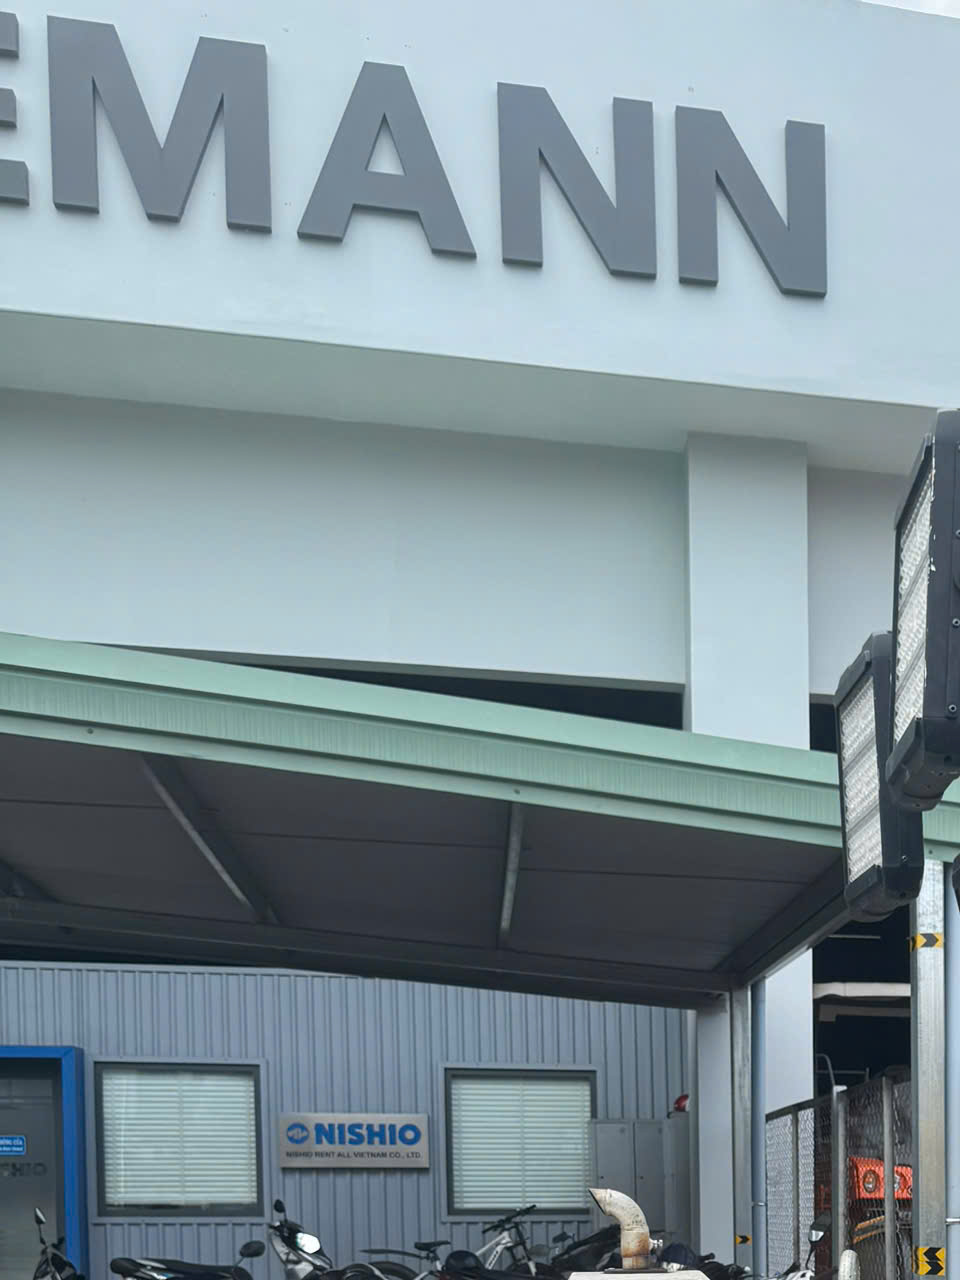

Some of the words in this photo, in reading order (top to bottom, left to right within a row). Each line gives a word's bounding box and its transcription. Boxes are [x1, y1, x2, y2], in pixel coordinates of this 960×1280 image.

[314, 1122, 422, 1146] NISHIO
[315, 1151, 336, 1159] RENT
[337, 1151, 351, 1159] ALL
[353, 1151, 388, 1159] VIETNAM
